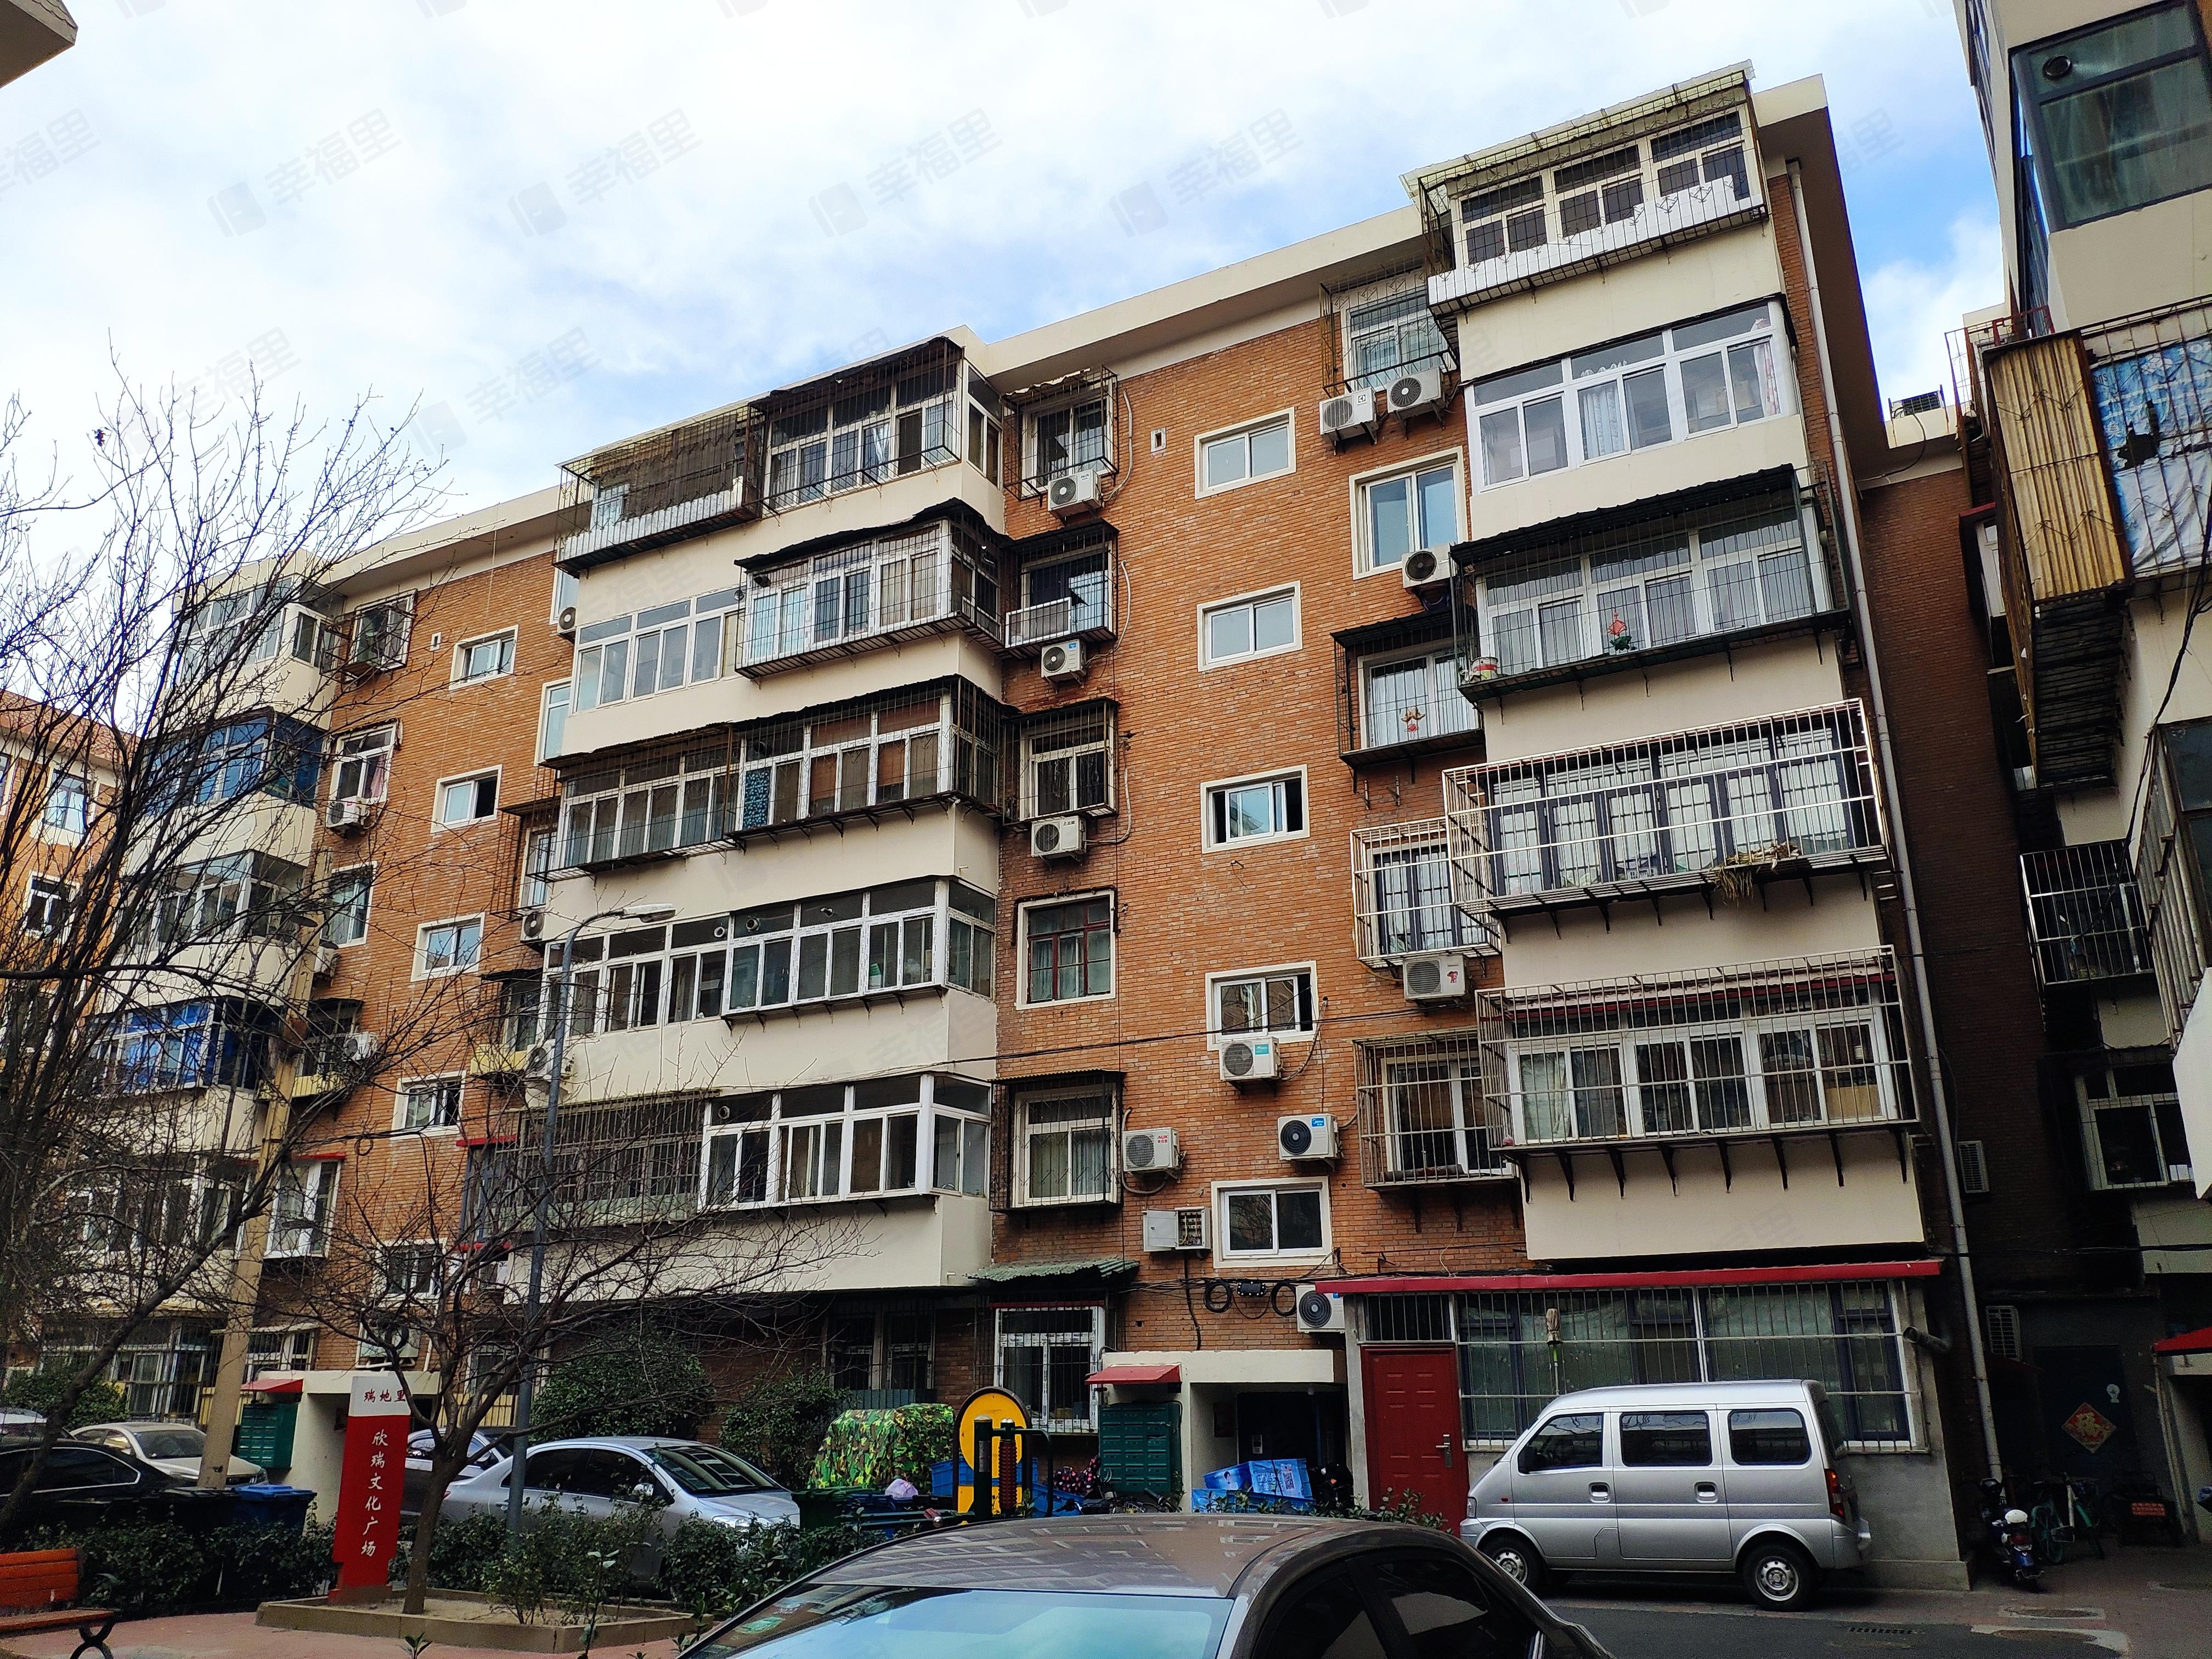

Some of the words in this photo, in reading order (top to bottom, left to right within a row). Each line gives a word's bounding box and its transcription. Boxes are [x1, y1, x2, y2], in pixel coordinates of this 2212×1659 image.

[364, 1389, 405, 1403] 瑞地里
[360, 1429, 388, 1557] 欣瑞文化广场
